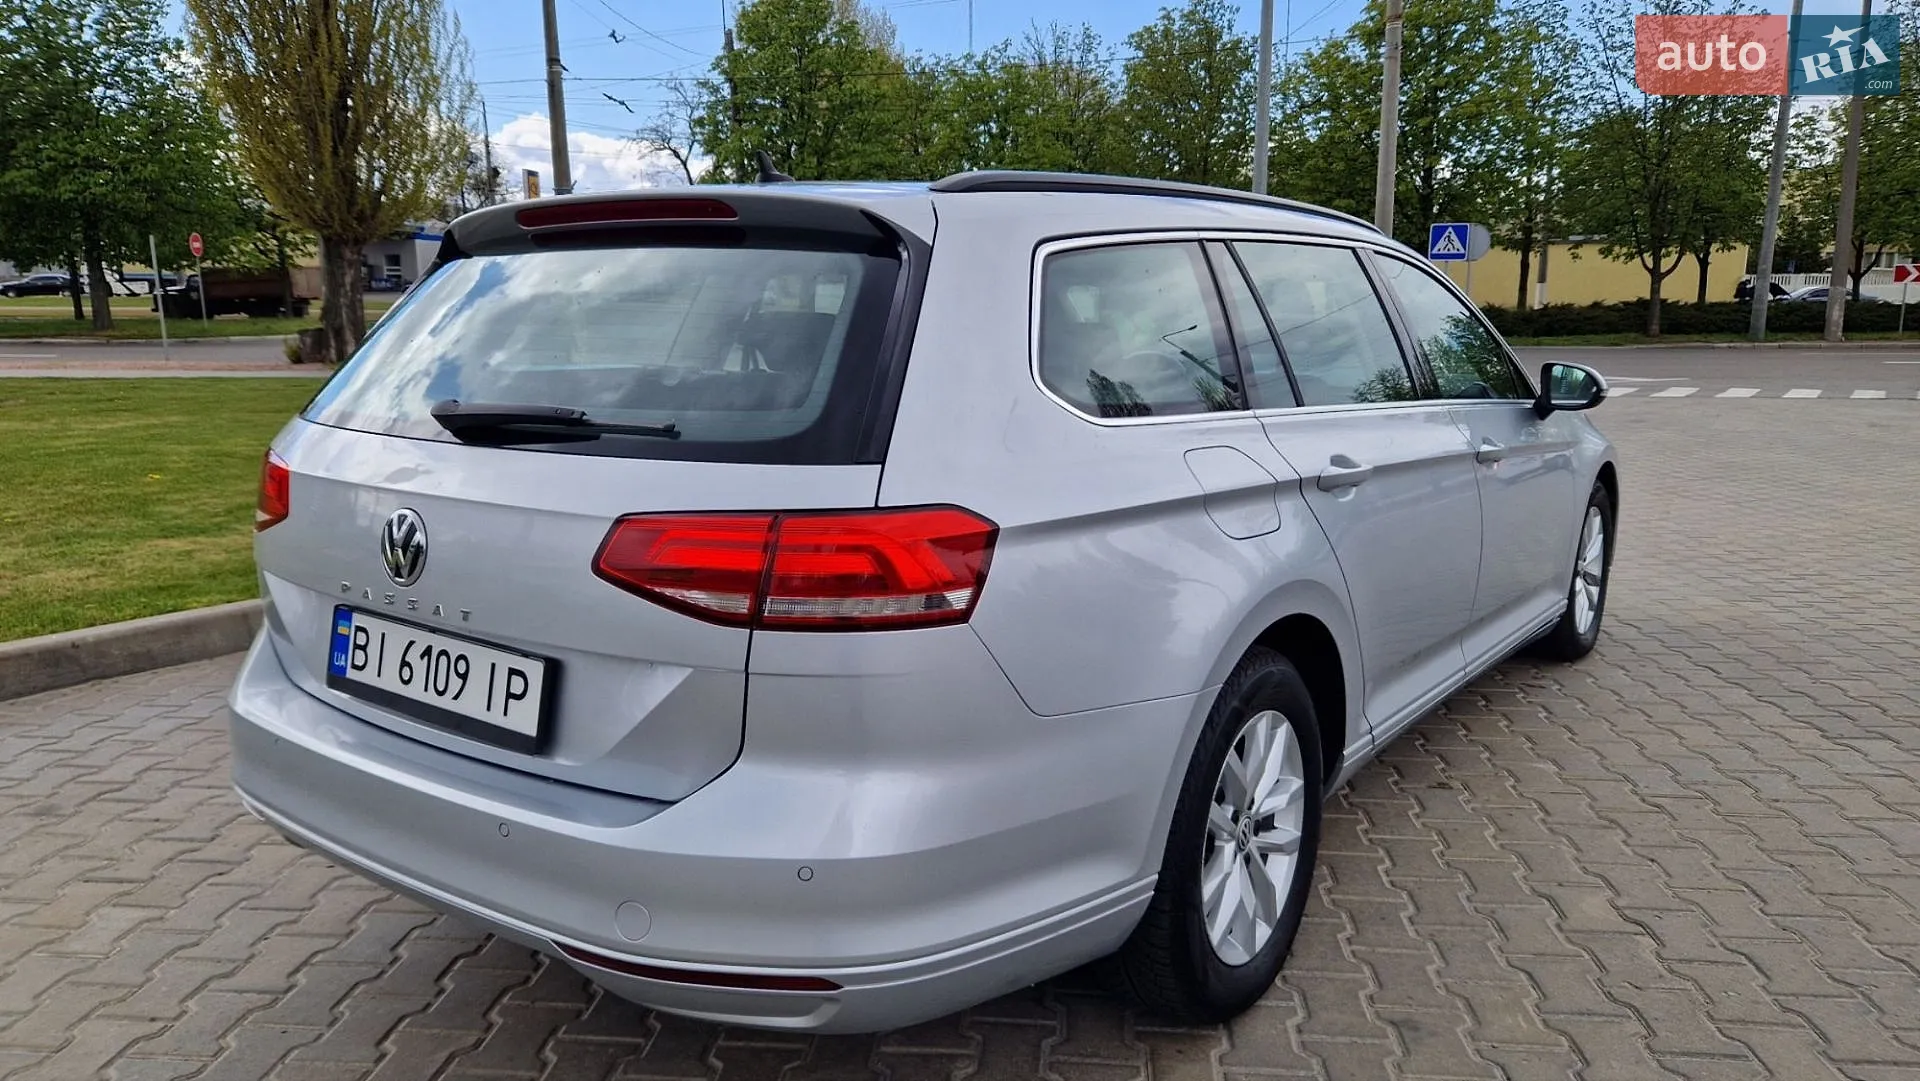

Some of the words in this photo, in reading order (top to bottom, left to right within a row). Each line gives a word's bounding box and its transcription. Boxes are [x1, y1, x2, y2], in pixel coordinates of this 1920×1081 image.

[340, 581, 472, 622] PASSAT
[334, 652, 347, 668] UA
[350, 624, 386, 678] BI
[398, 639, 470, 701] 6109
[486, 662, 529, 717] IP
